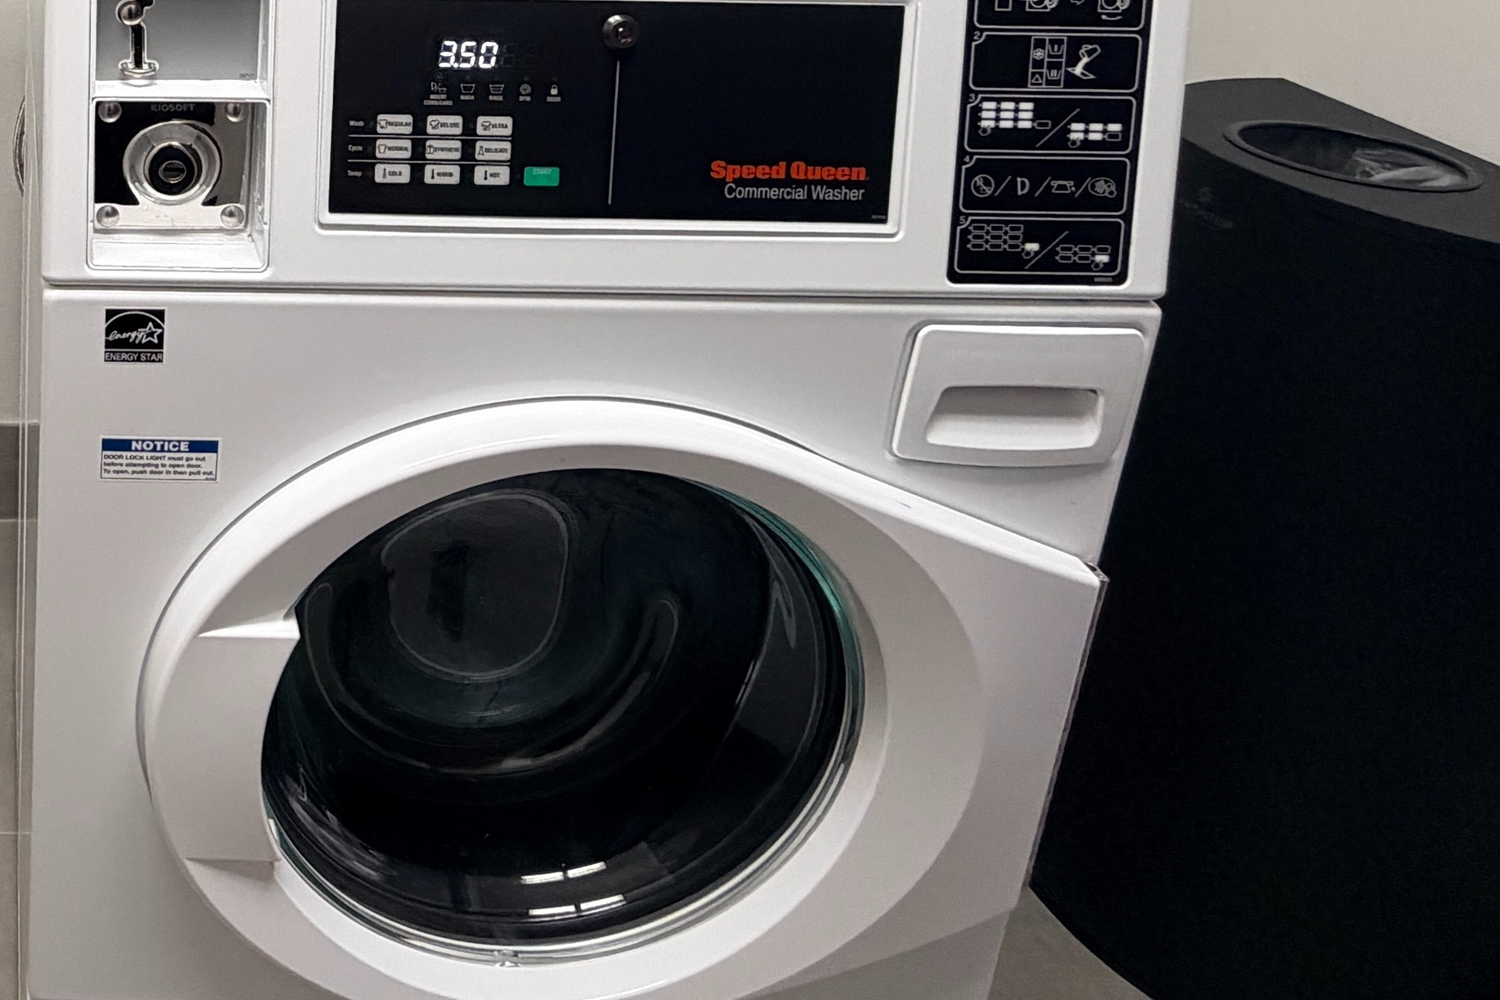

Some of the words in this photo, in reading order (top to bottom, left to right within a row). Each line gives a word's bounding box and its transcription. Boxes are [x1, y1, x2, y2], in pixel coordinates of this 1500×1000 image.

[973, 32, 981, 40] 2
[438, 40, 499, 69] 3.50
[968, 94, 976, 102] 3
[150, 103, 196, 112] KIOSOFT
[710, 160, 786, 182] Speed
[790, 160, 868, 181] Queen
[724, 182, 808, 200] Commercial
[810, 184, 866, 201] Washer
[959, 216, 966, 224] 5
[107, 329, 145, 344] energy
[105, 352, 139, 361] ENERGY
[140, 353, 163, 362] STAR
[131, 440, 190, 452] NOTICE
